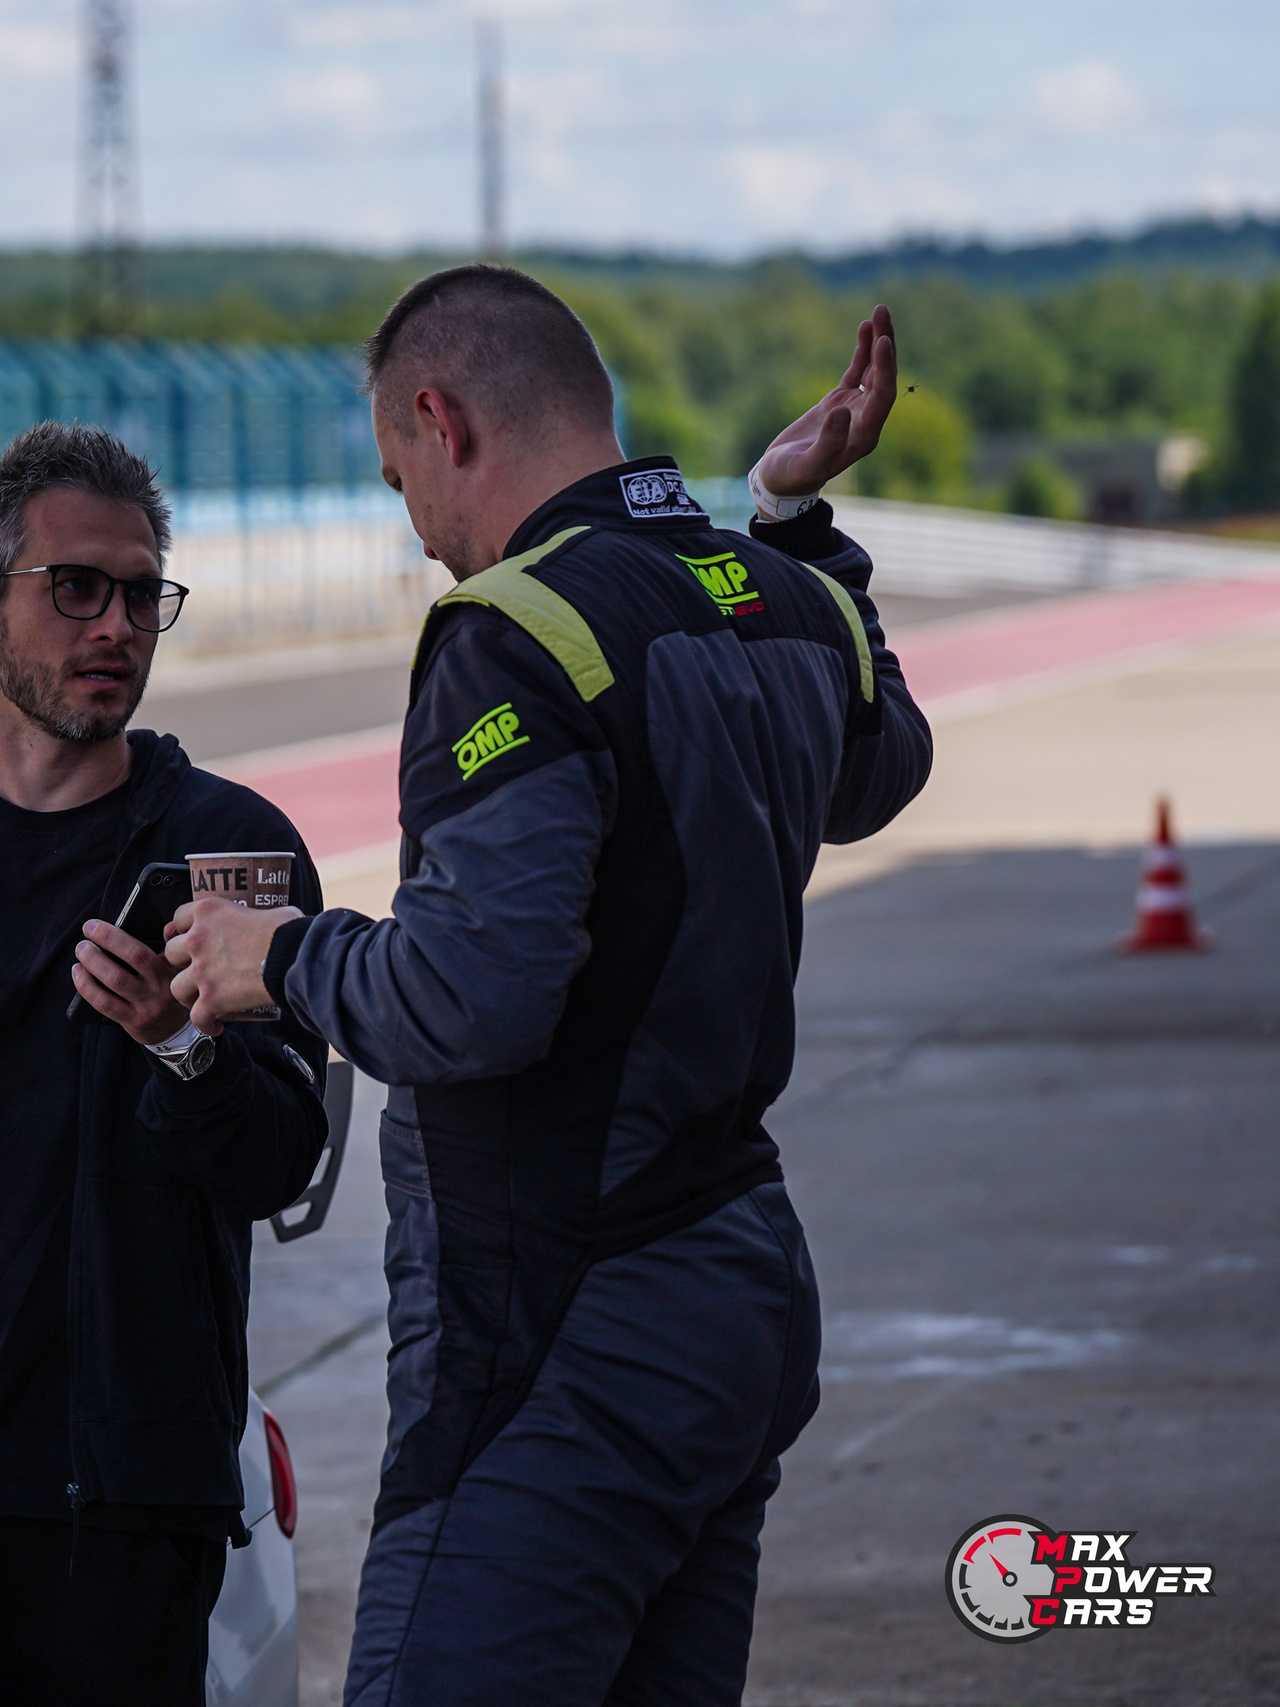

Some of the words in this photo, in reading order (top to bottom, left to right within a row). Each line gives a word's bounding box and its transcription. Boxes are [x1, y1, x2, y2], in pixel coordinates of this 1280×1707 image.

[630, 482, 664, 501] FIA
[457, 711, 520, 772] OMP
[192, 868, 248, 892] LATTE
